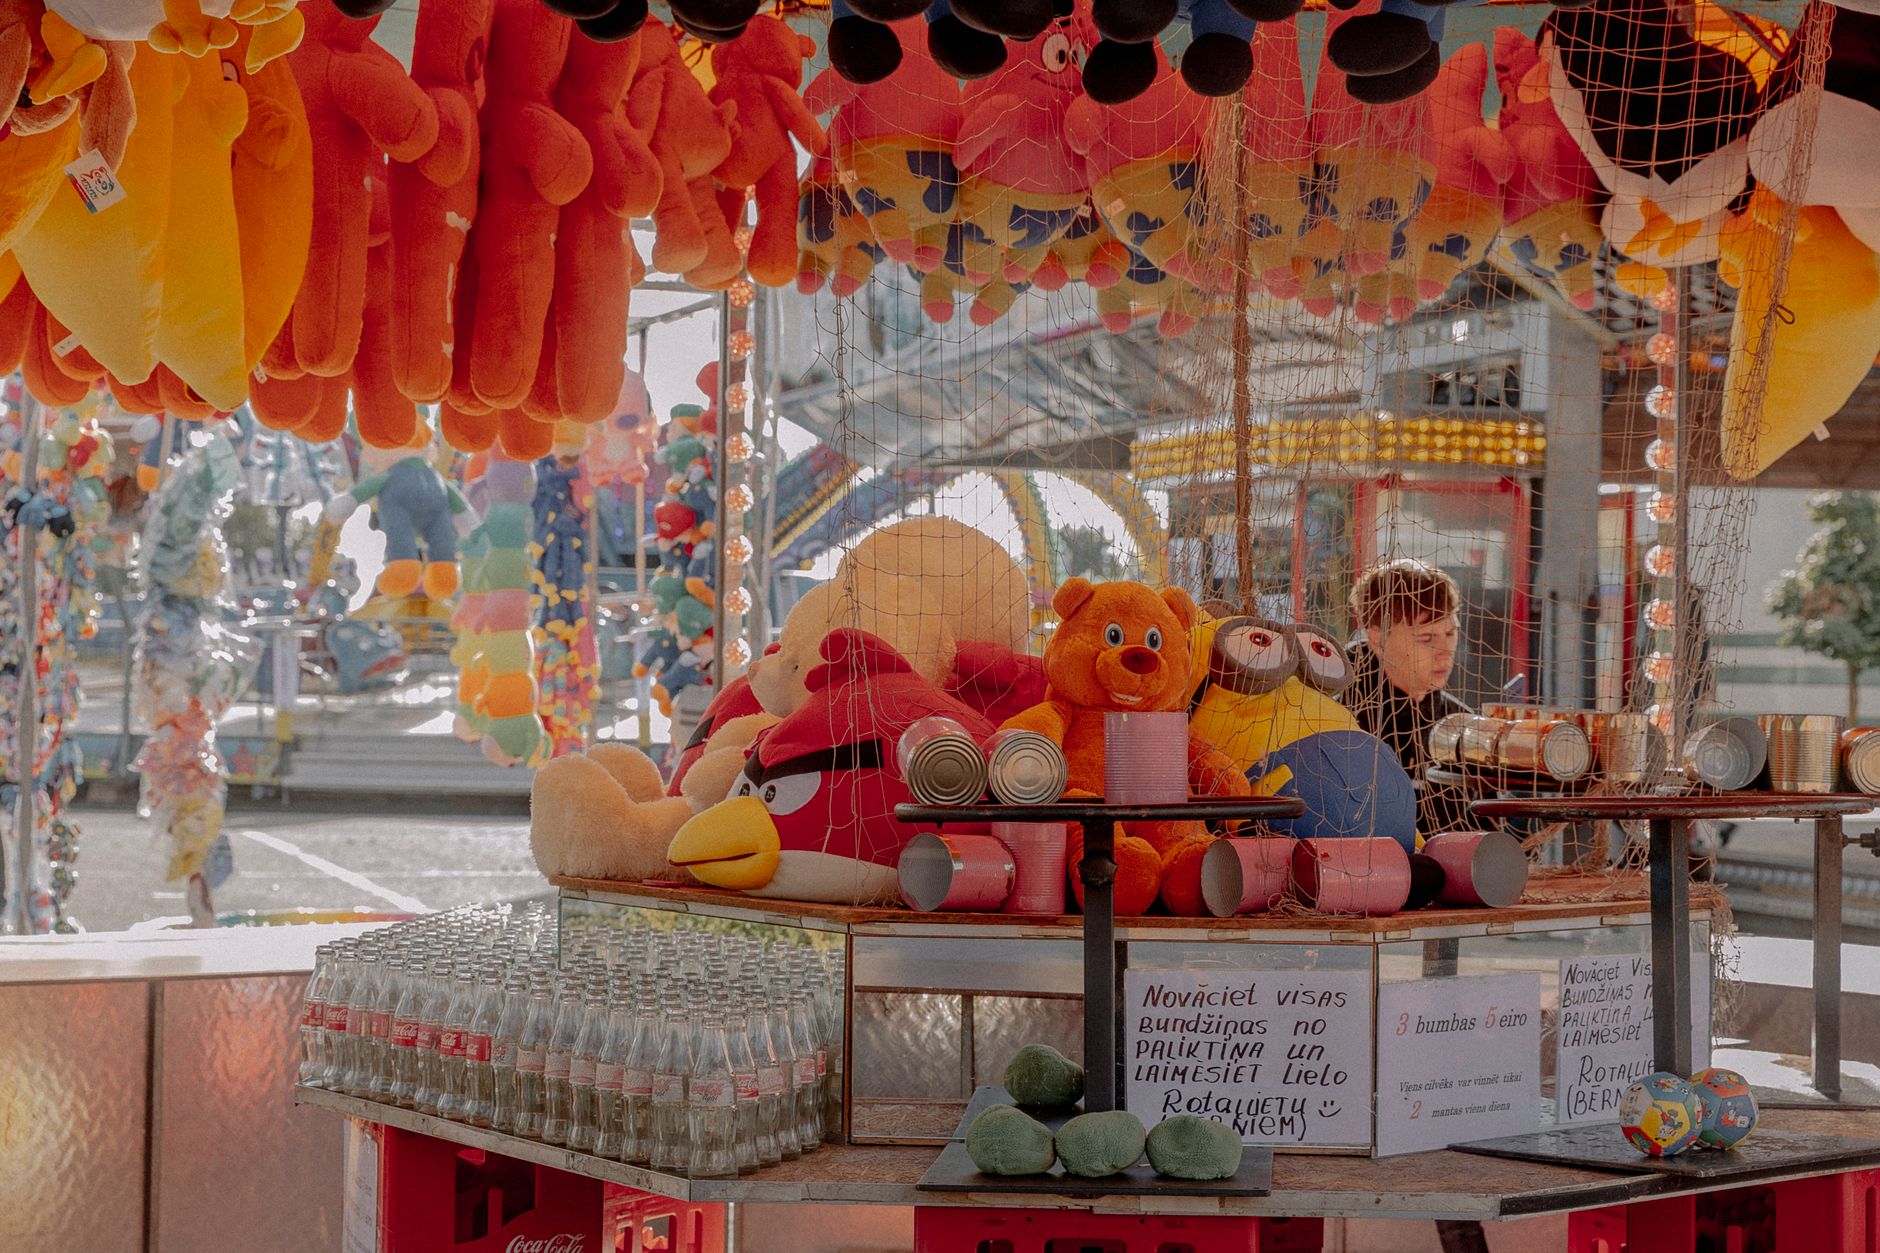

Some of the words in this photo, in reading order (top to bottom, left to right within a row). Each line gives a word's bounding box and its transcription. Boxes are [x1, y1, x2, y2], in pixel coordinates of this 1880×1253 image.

[1396, 1012, 1409, 1036] 3
[1415, 1013, 1477, 1034] bumbas
[1484, 1006, 1498, 1029] 5
[1499, 1008, 1527, 1028] eiro
[1399, 1081, 1422, 1093] Viens
[1424, 1078, 1454, 1091] cilvēks
[1457, 1079, 1472, 1088] var
[1503, 1071, 1523, 1083] tikai
[1409, 1099, 1422, 1119] 2
[1432, 1106, 1463, 1118] mantas
